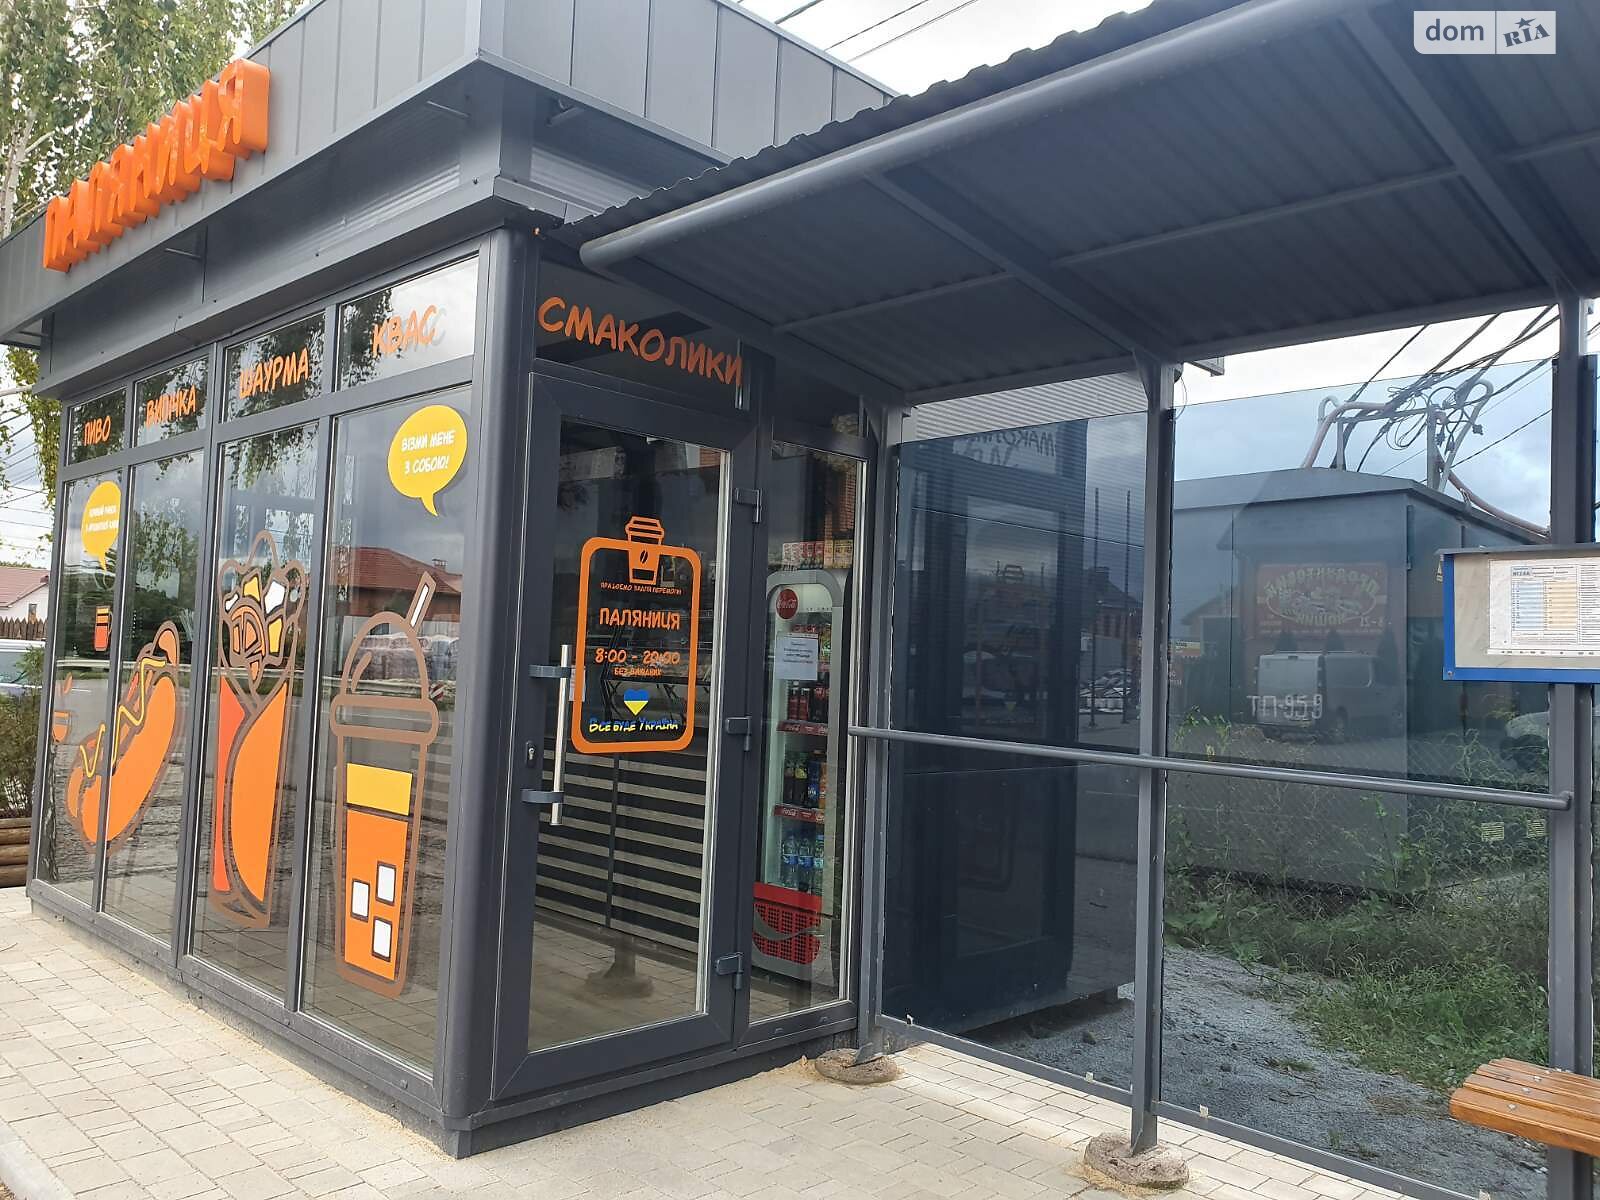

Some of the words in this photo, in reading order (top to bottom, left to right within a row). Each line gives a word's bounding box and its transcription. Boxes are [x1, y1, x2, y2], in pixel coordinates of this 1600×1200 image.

[43, 58, 270, 273] ПАЛЯНИЦЯ
[371, 305, 437, 358] КВАС
[537, 296, 743, 387] СМАКОЛИКИ
[239, 348, 311, 400] ШАУРМА
[145, 385, 197, 429] ВИПІЧКА
[83, 415, 112, 446] ПИВО
[429, 430, 456, 448] МЕНЕ
[412, 454, 450, 474] СОБОЮ!
[599, 607, 681, 630] ПАЛЯНИЦЯ
[595, 647, 627, 664] 8:00
